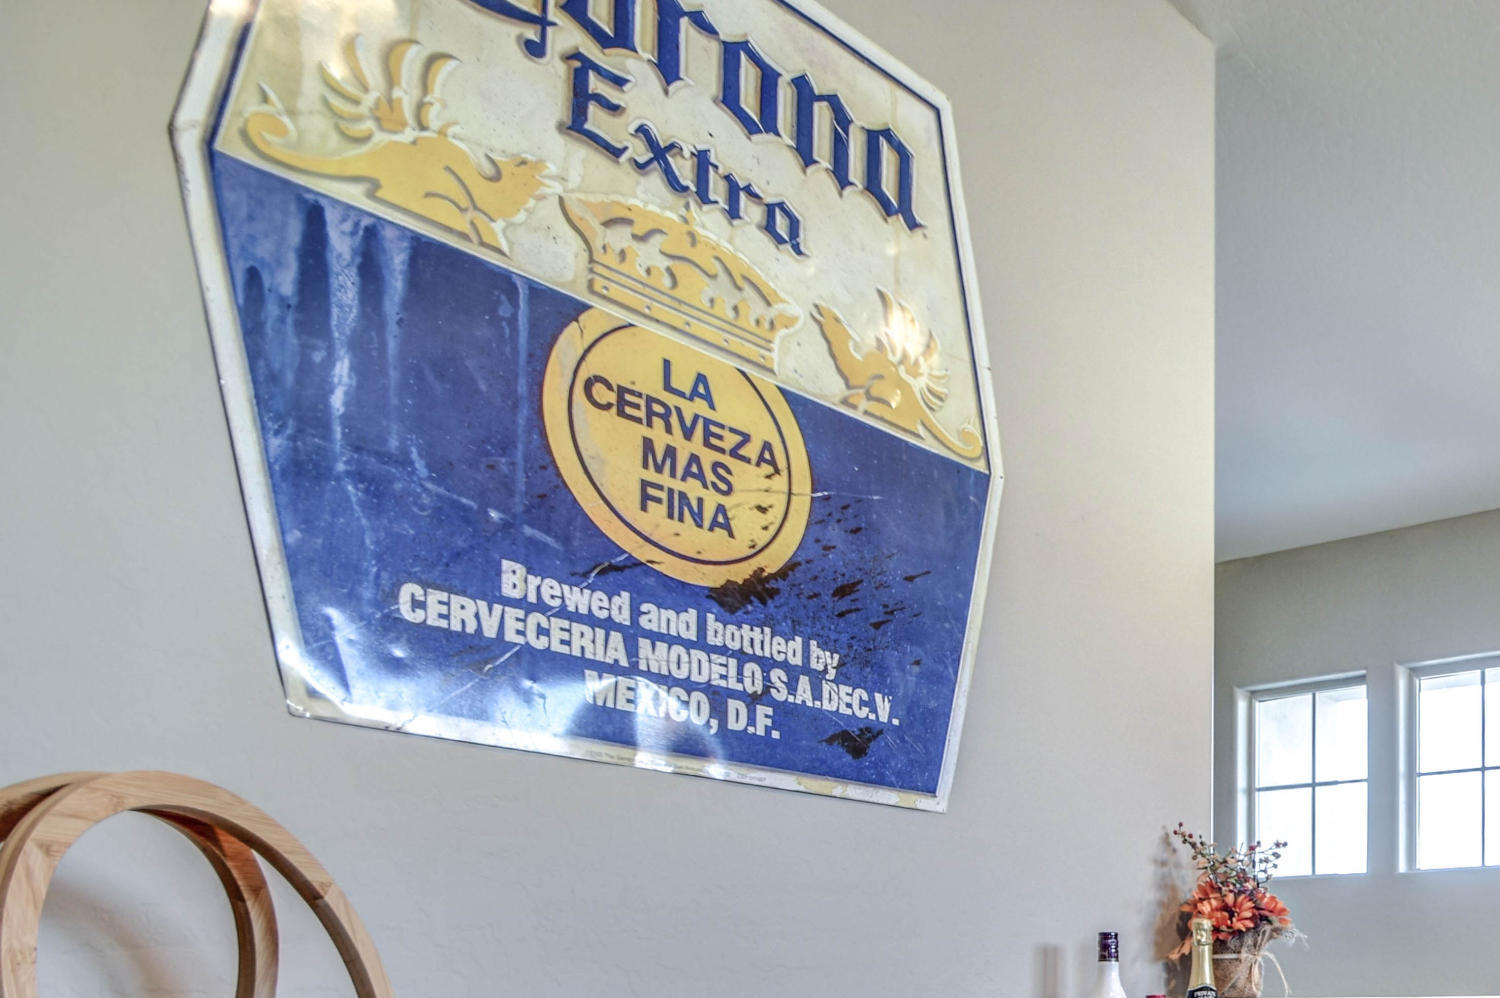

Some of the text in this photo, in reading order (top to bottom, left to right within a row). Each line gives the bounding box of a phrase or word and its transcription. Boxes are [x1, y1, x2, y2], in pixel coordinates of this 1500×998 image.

[562, 47, 810, 257] Extra
[583, 374, 781, 476] CERVEZA
[662, 358, 717, 412] LA
[641, 435, 734, 497] MAS
[639, 478, 736, 540] FINA
[398, 582, 630, 668] CERVECERIA
[637, 637, 764, 696] MODELO
[501, 558, 840, 680] Brewed and bottled by
[726, 698, 781, 740] D.F.
